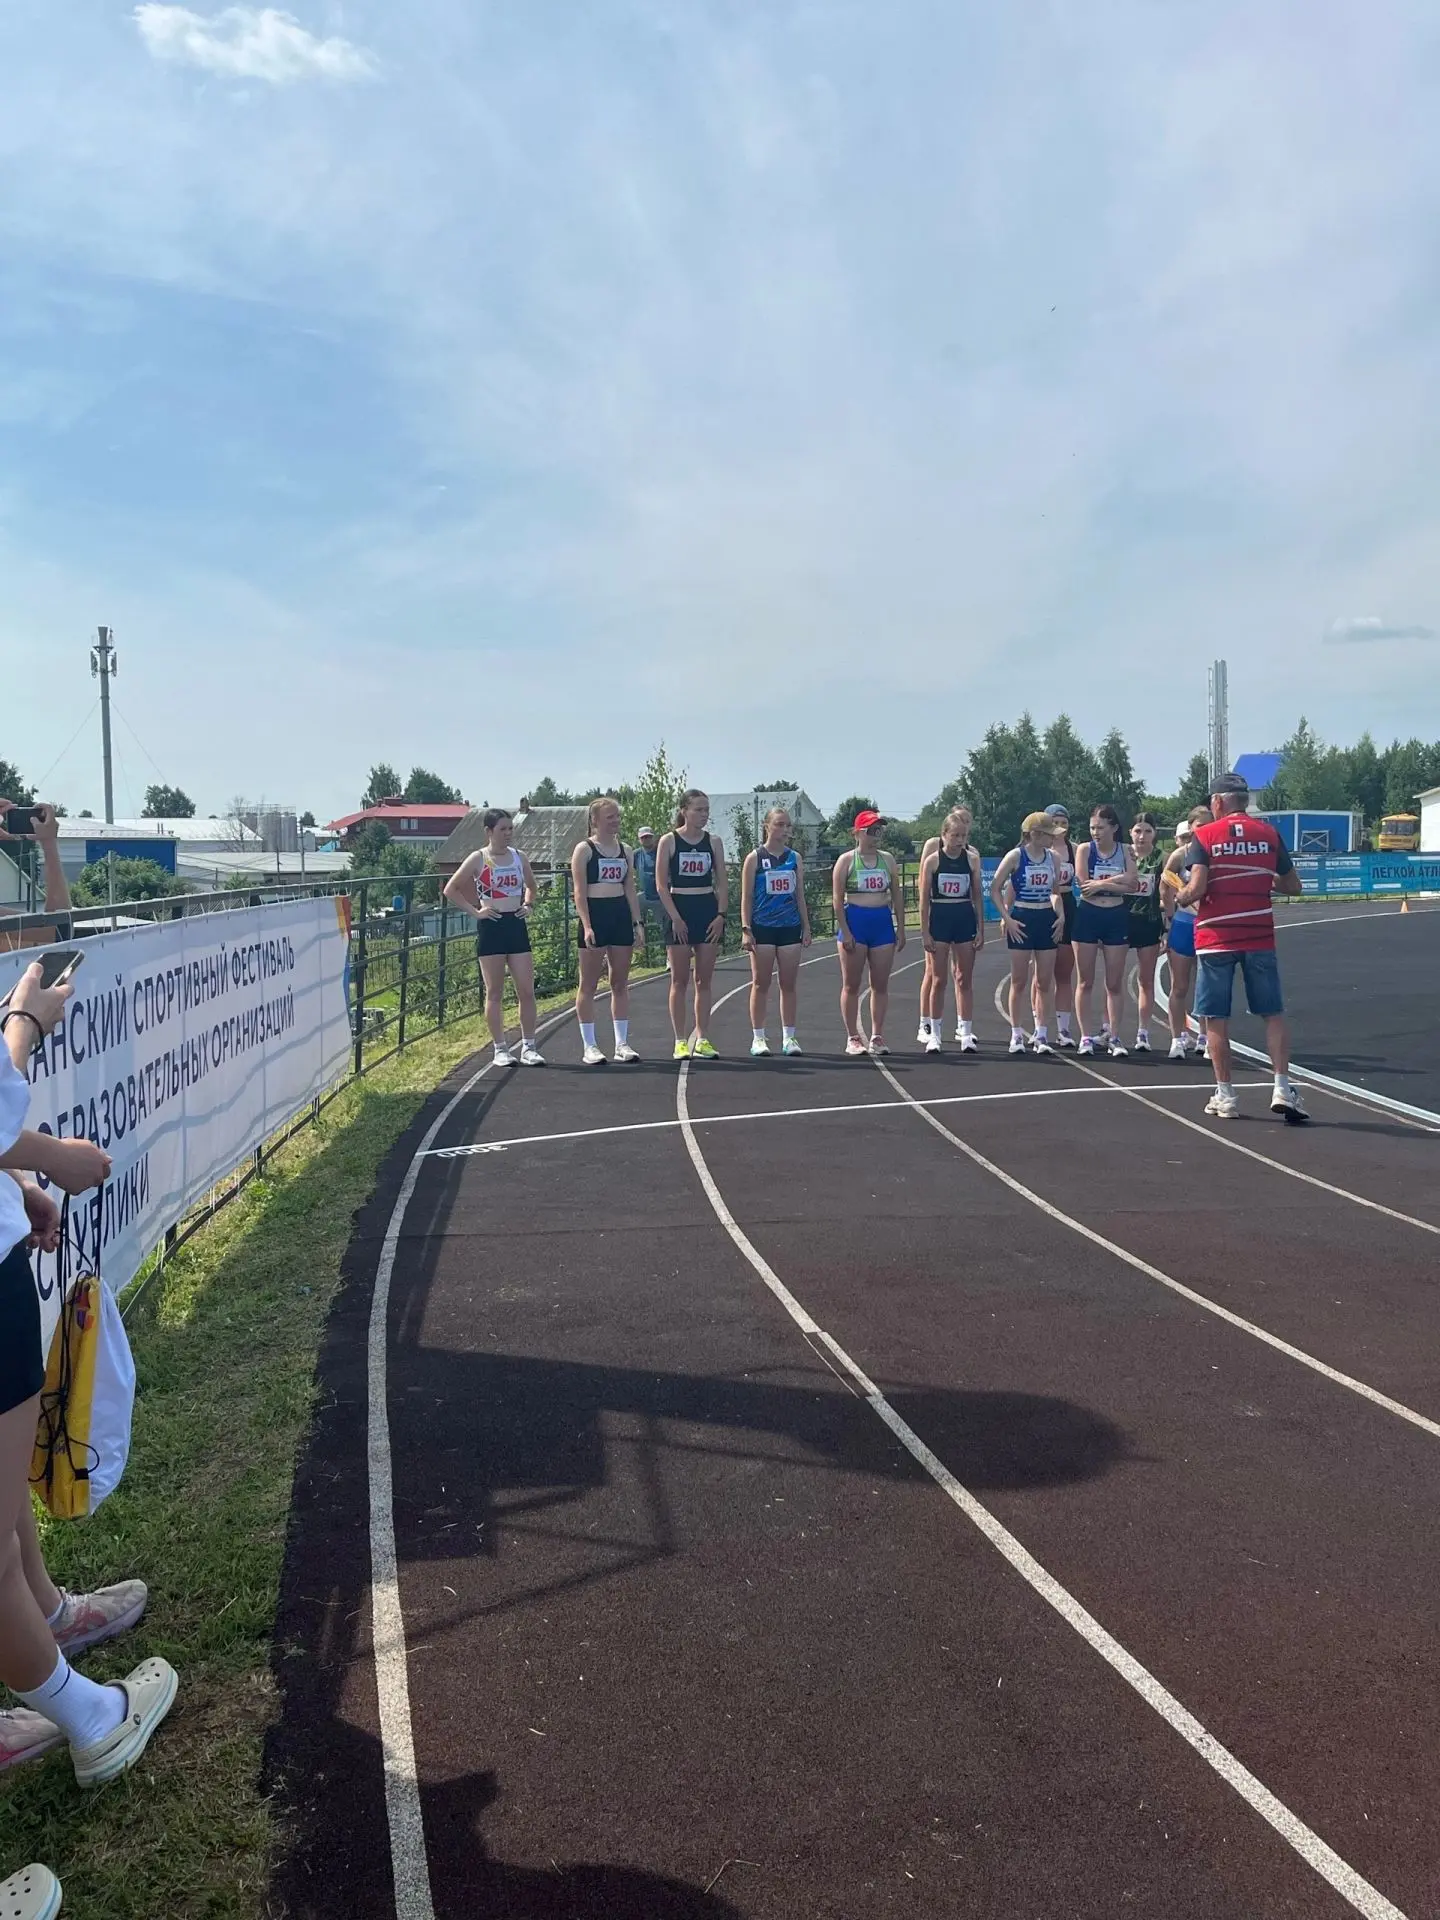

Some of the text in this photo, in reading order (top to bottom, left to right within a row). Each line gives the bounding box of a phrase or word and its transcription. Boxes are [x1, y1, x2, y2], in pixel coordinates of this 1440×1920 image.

[1211, 841, 1269, 857] СУДЬЯ
[601, 866, 622, 880] 233
[682, 860, 704, 873] 204
[1372, 863, 1416, 879] ЛЕГКОЙ
[496, 874, 518, 888] 245
[770, 879, 790, 891] 195
[865, 876, 884, 889] 183
[1029, 874, 1048, 886] 152
[942, 882, 960, 893] 173
[26, 935, 295, 1086] АНСКИЙ СПОРТИВНЫЙ ФЕСТИВАЛЬ
[211, 983, 295, 1068] ОРГАНИЗАЦИЙ
